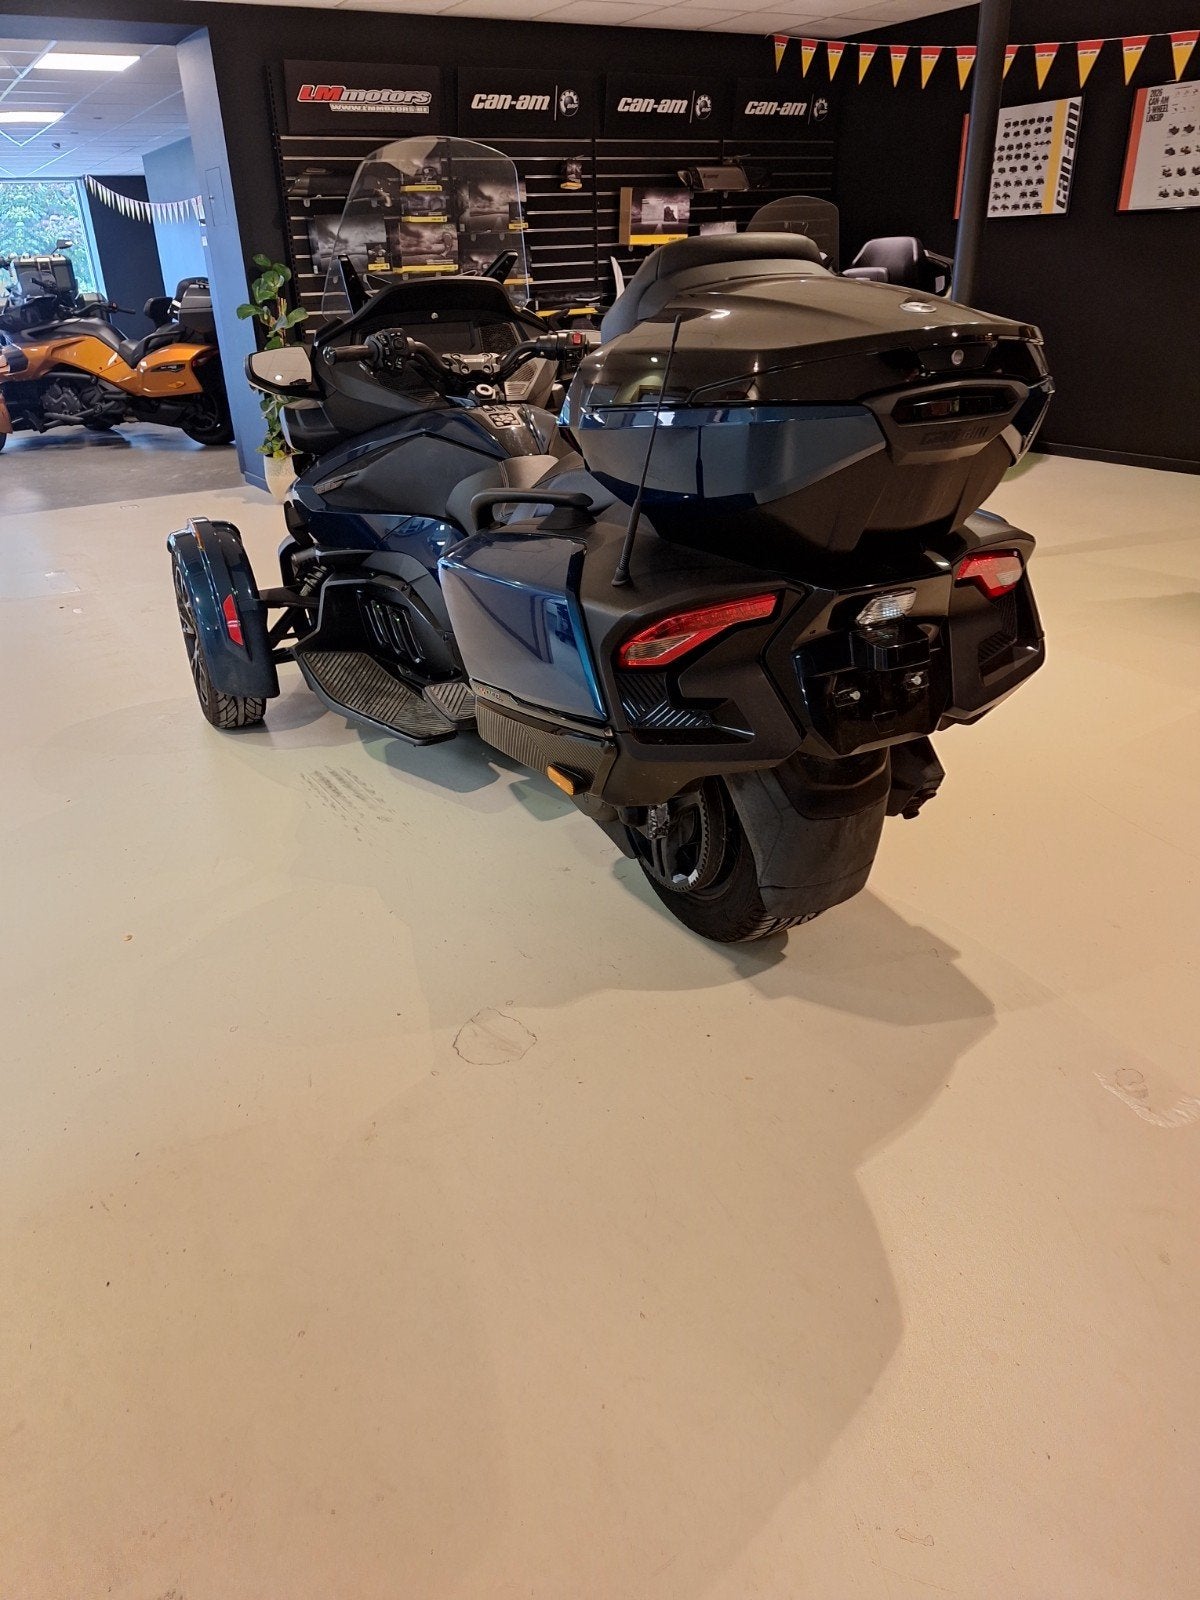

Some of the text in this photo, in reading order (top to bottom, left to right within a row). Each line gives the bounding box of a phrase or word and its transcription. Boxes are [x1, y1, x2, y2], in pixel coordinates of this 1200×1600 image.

[471, 93, 551, 110] can-am
[617, 97, 689, 114] can-am
[744, 101, 808, 116] can-am
[1056, 102, 1079, 209] can-am
